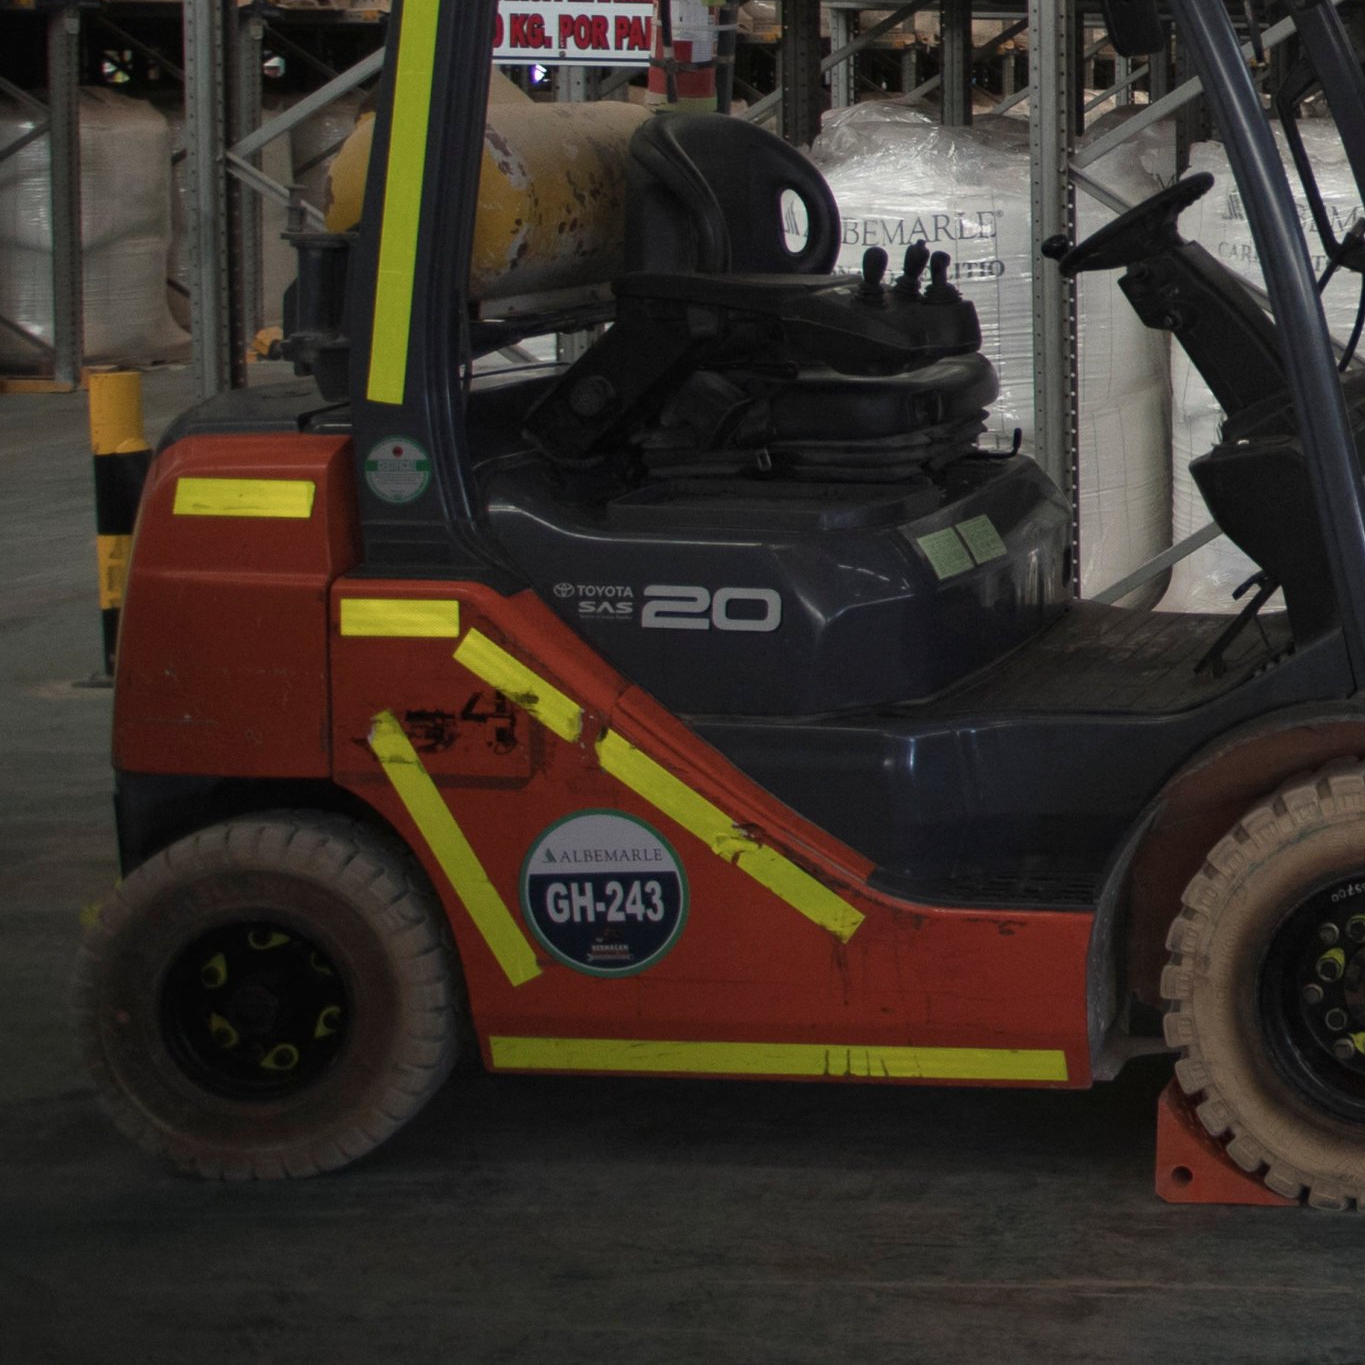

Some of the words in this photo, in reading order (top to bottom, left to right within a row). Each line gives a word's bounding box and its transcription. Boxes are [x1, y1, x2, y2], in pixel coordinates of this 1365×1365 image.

[509, 13, 553, 49] KG.
[558, 14, 610, 51] POR
[842, 211, 998, 246] BEMARLE
[947, 259, 1006, 281] ITIO
[577, 585, 635, 598] TOYOTA
[578, 600, 634, 614] SAS
[641, 584, 783, 633] 20
[559, 848, 664, 863] ALBEMARLE
[545, 879, 666, 924] GH-243
